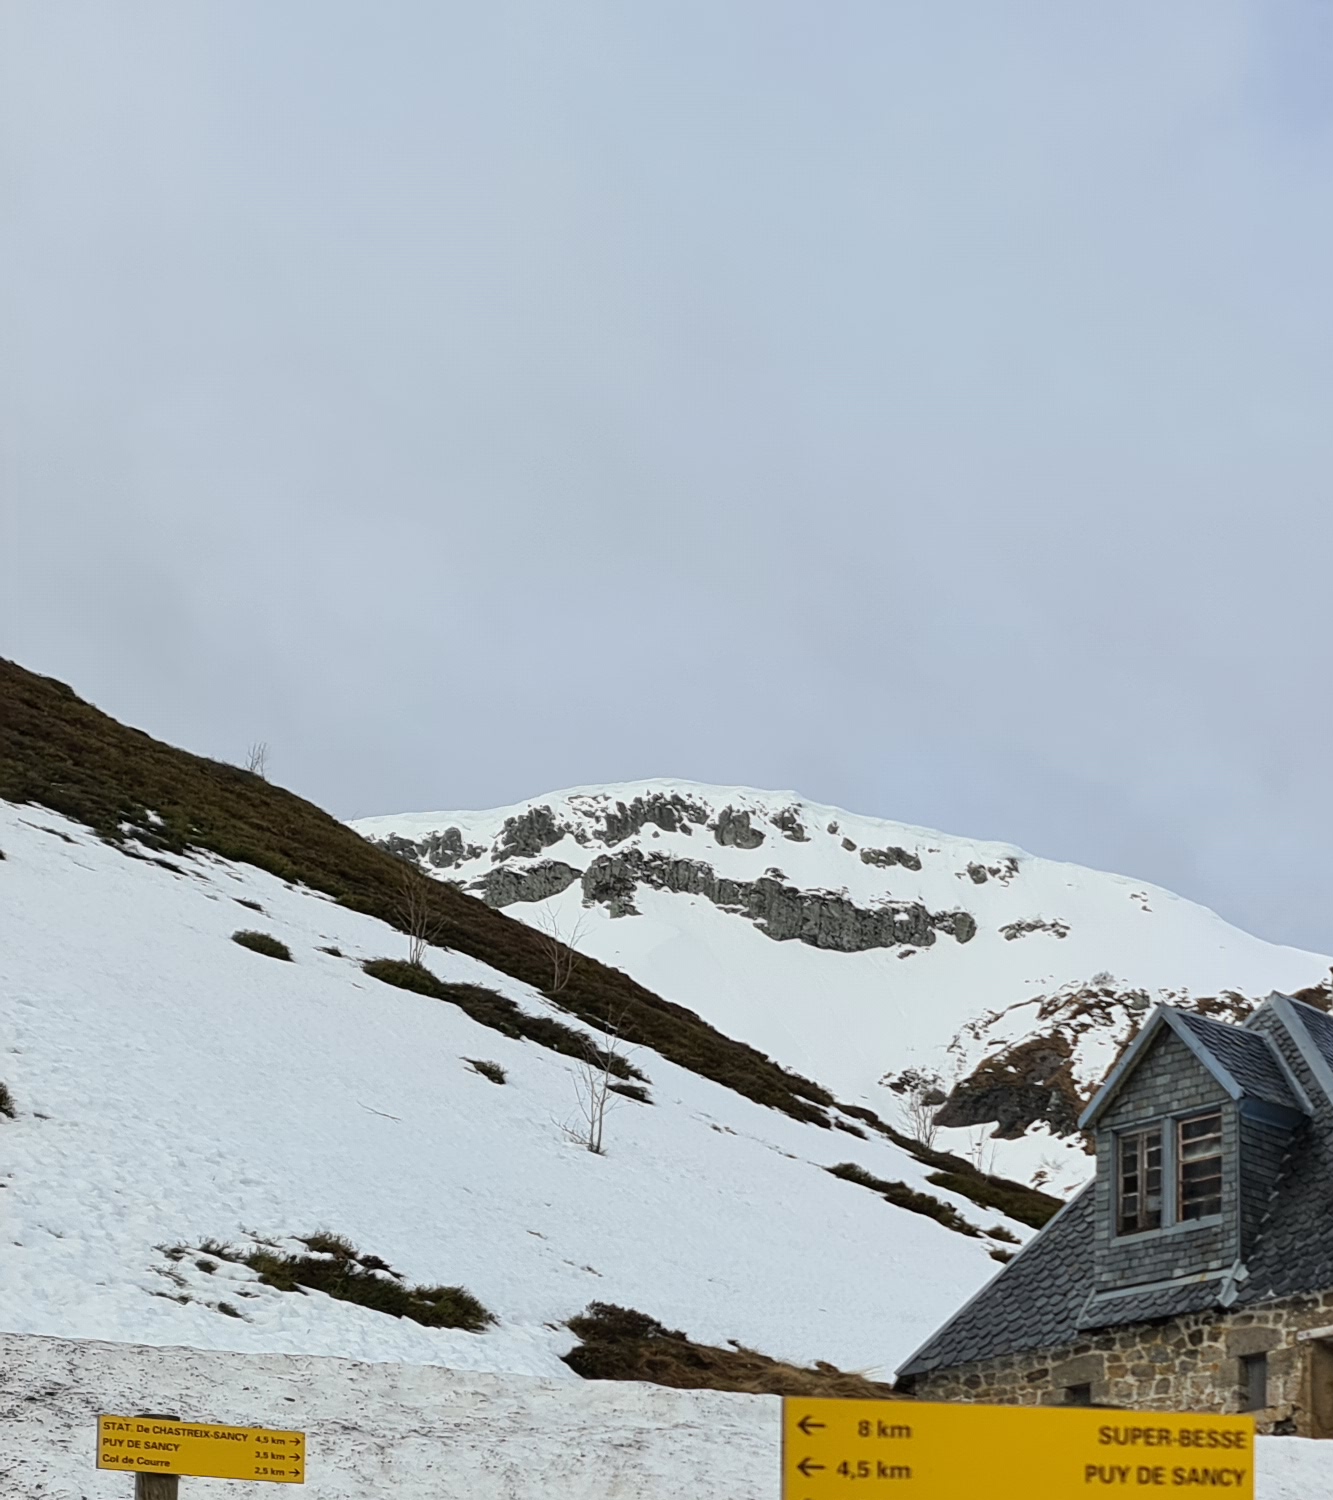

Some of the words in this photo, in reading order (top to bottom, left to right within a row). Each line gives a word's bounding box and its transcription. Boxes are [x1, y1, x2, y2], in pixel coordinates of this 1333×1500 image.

[153, 1426, 248, 1442] CHASTREIX-SANCY
[858, 1420, 871, 1438] 8
[877, 1420, 912, 1439] km
[103, 1438, 124, 1447] PUY
[127, 1440, 141, 1448] DE
[144, 1441, 180, 1452] SANCY
[271, 1436, 286, 1445] km
[1098, 1426, 1247, 1450] SUPER-BESSE
[102, 1454, 119, 1463] Col
[122, 1456, 134, 1464] de
[137, 1457, 170, 1467] Courre
[271, 1452, 285, 1460] km
[271, 1468, 285, 1476] km
[836, 1460, 870, 1482] 4,5
[876, 1461, 912, 1480] km
[1085, 1465, 1131, 1484] PUY
[1137, 1466, 1166, 1485] DE
[1172, 1467, 1246, 1487] SANCY
